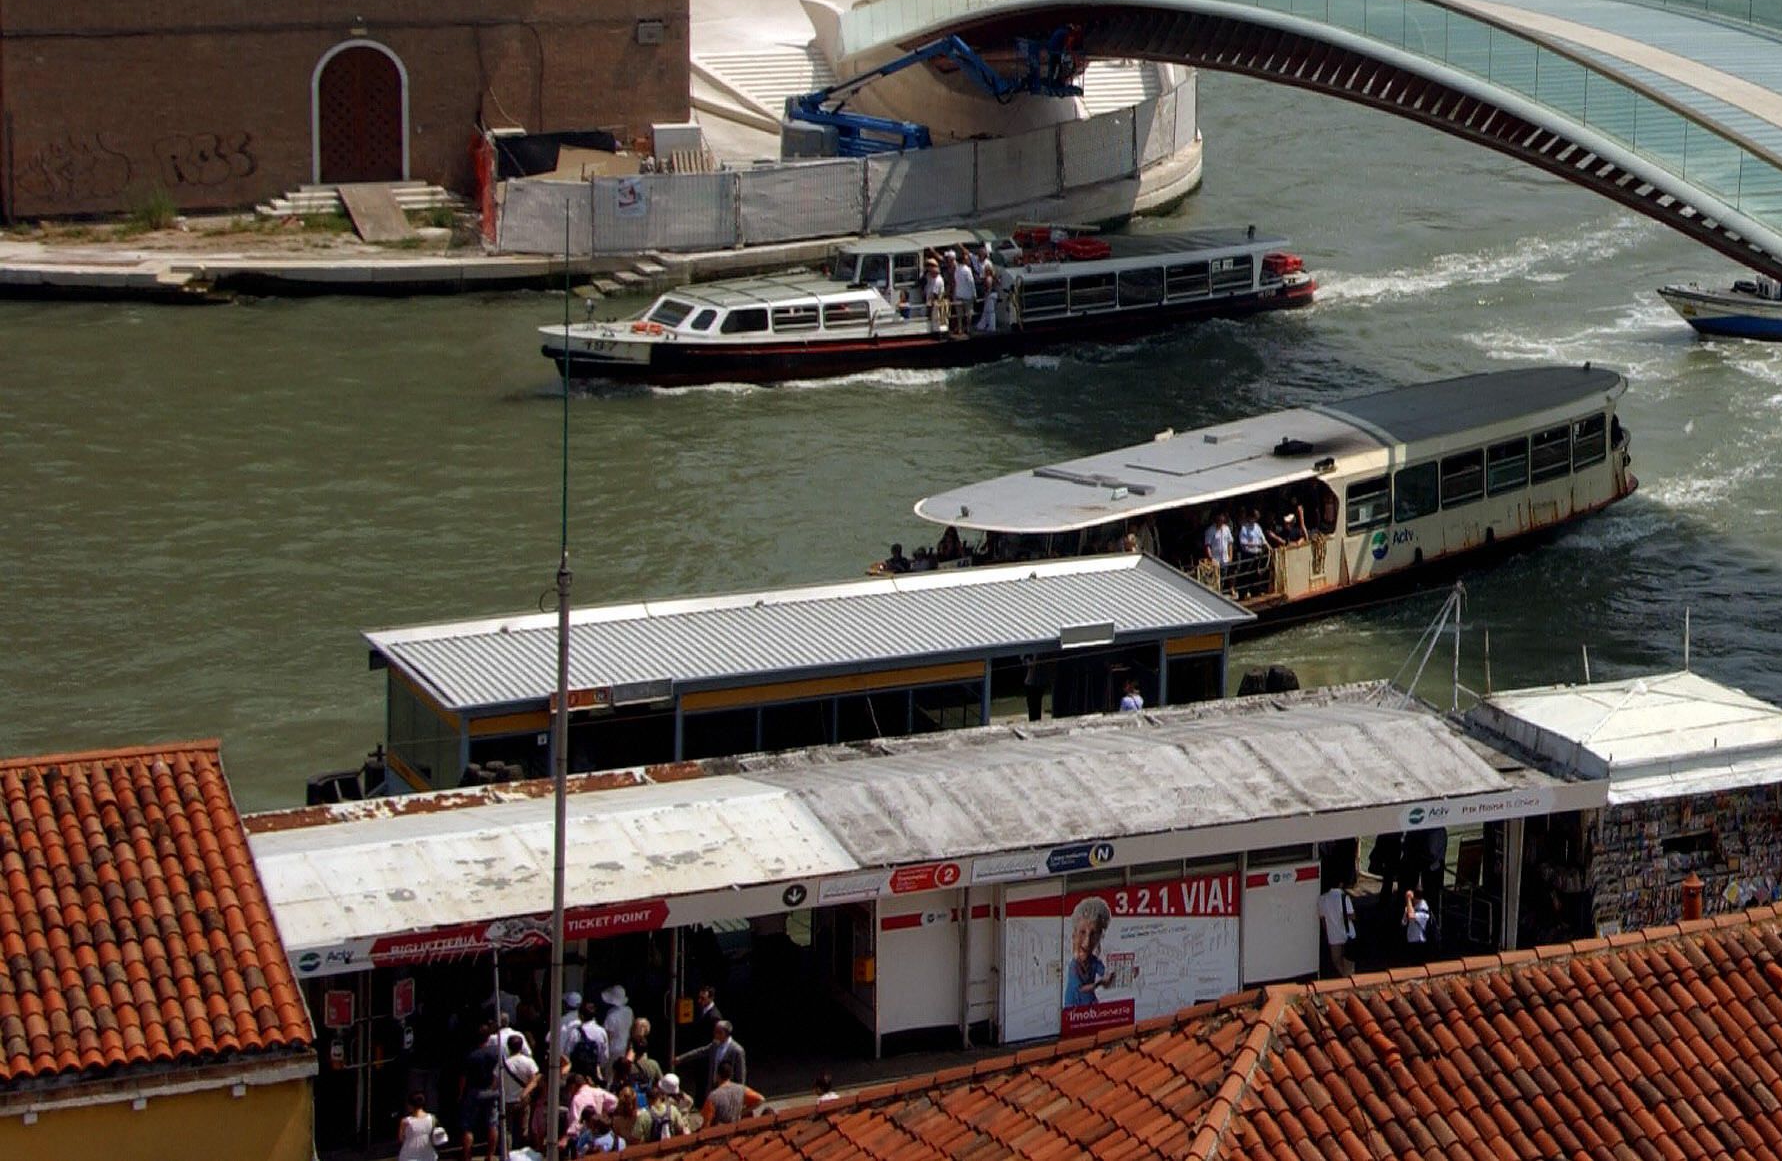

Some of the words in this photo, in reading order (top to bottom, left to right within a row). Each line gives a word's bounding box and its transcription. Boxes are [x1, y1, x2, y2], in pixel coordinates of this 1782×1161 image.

[1097, 848, 1109, 861] N
[943, 868, 953, 882] 2
[1115, 886, 1175, 914] 3.2.1.
[1181, 876, 1233, 914] VIA!
[567, 915, 609, 932] TICKET
[613, 909, 652, 924] POINT
[390, 934, 477, 954] BIGLIETTERIA
